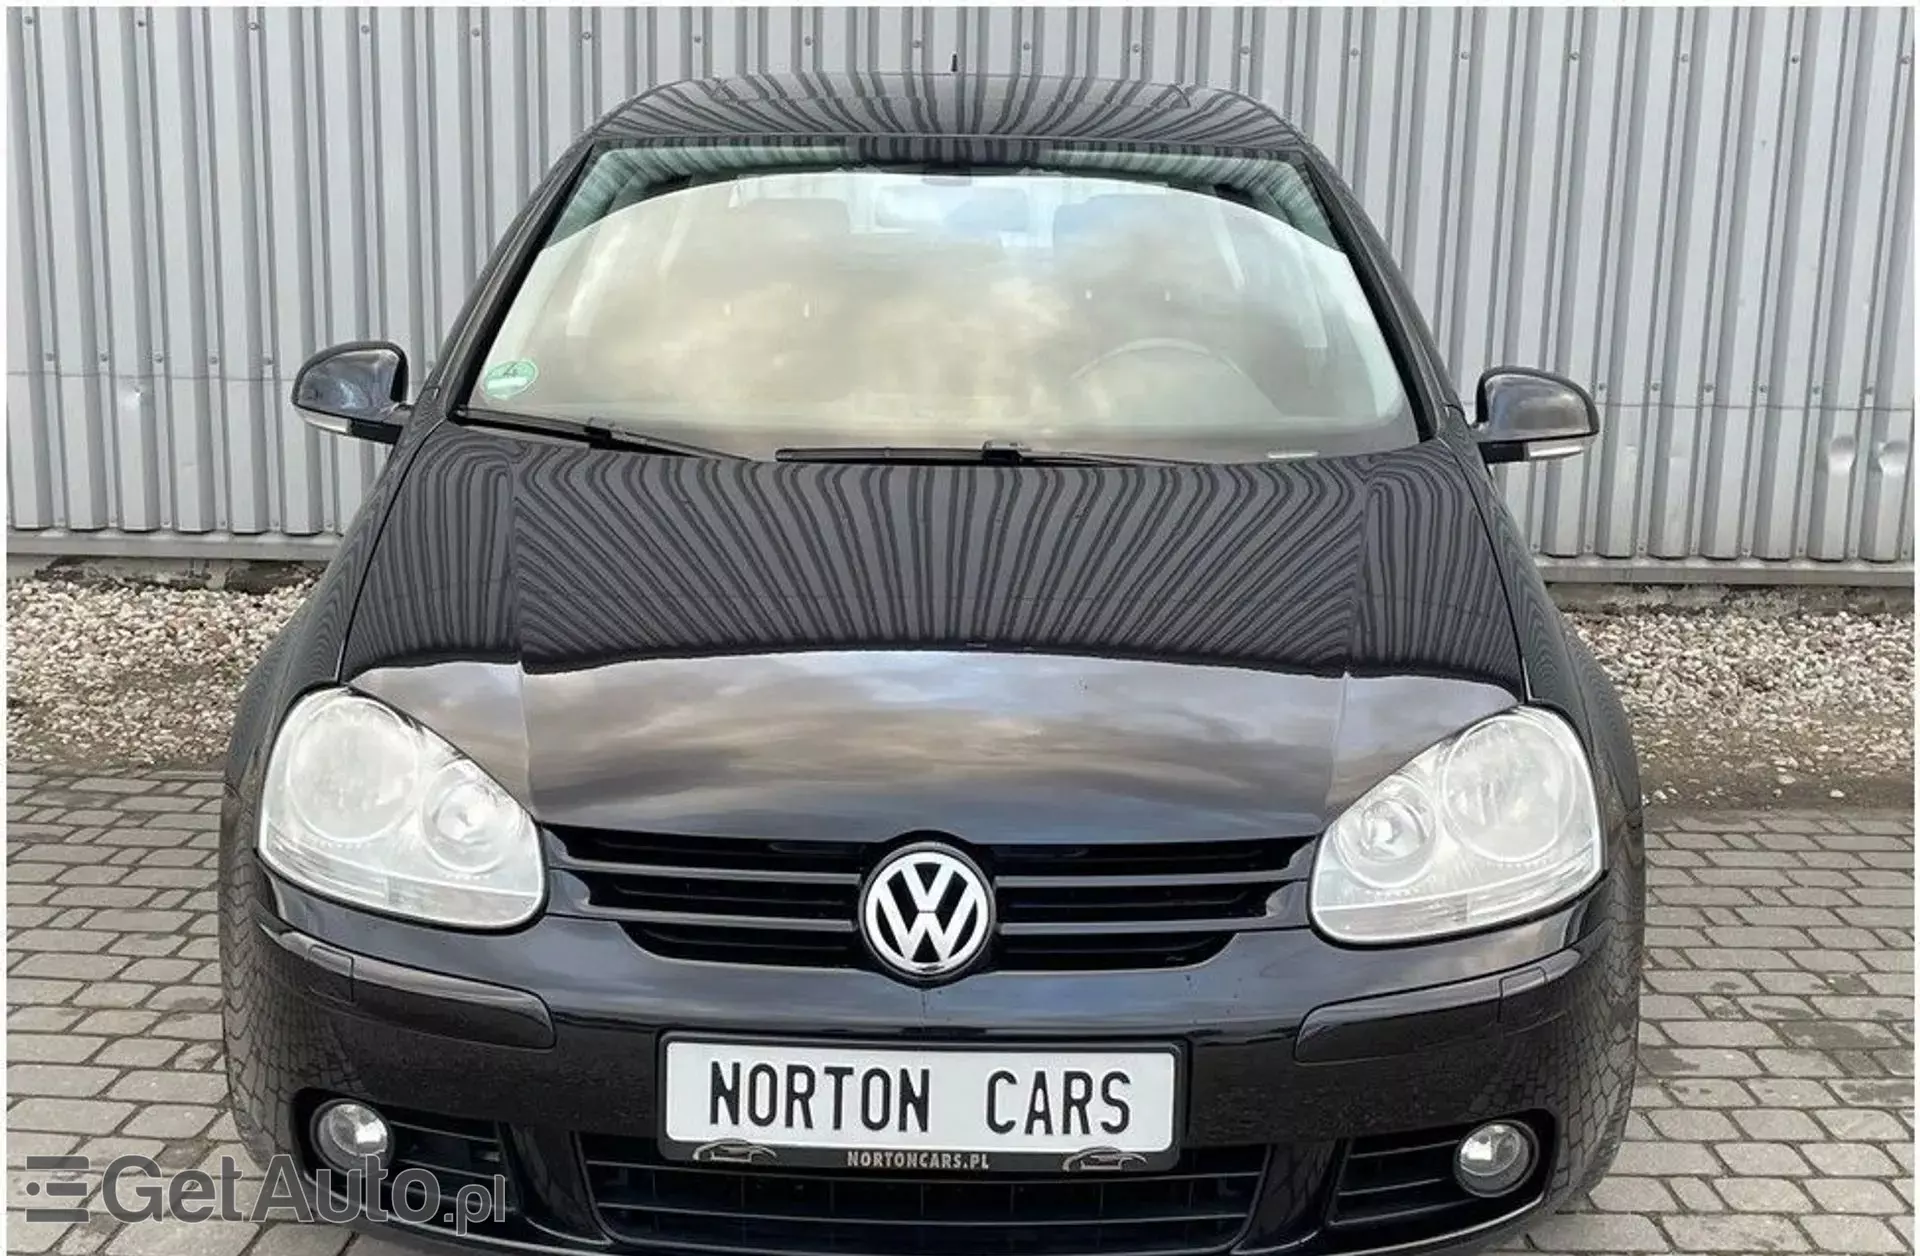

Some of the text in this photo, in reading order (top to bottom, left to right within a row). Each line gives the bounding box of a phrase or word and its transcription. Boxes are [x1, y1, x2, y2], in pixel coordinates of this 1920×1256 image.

[866, 852, 988, 973] VW
[709, 1061, 1132, 1136] NORTON CARS
[846, 1150, 990, 1170] NORTONCARS.PL
